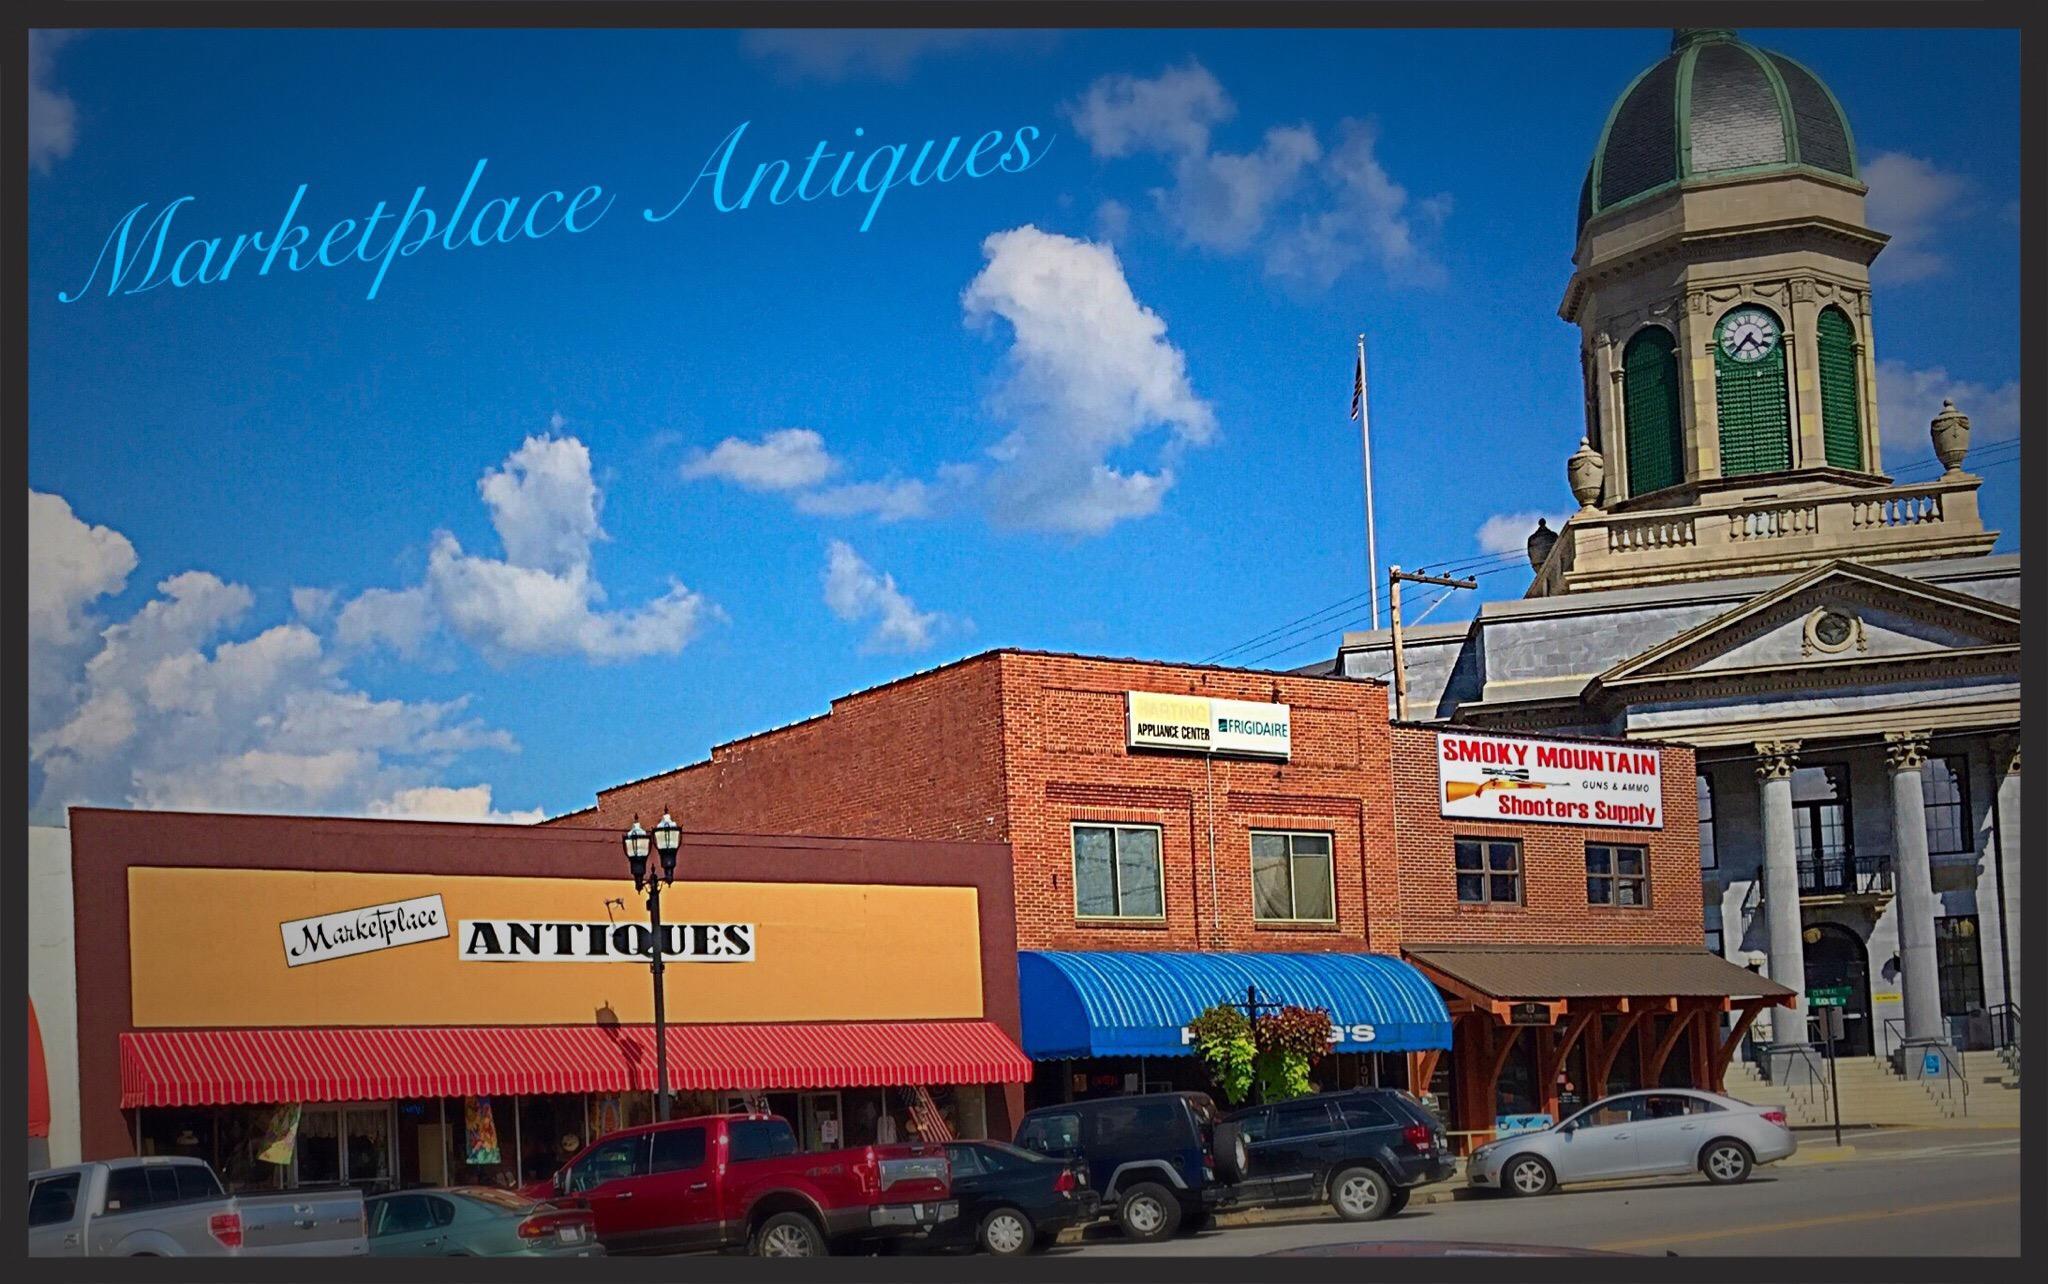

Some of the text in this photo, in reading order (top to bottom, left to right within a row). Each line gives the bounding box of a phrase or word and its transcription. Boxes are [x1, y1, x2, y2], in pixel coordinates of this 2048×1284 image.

[1137, 723, 1210, 741] APPLIANCE CENTER
[1228, 719, 1288, 738] FRIGIDAIRE
[1443, 739, 1656, 776] SMOKY MOUNTAIN
[1582, 780, 1650, 793] GUNS & AMMO
[1498, 794, 1656, 825] Shooters Supply
[290, 906, 439, 959] Marketplace
[466, 922, 750, 956] ANTIQUES
